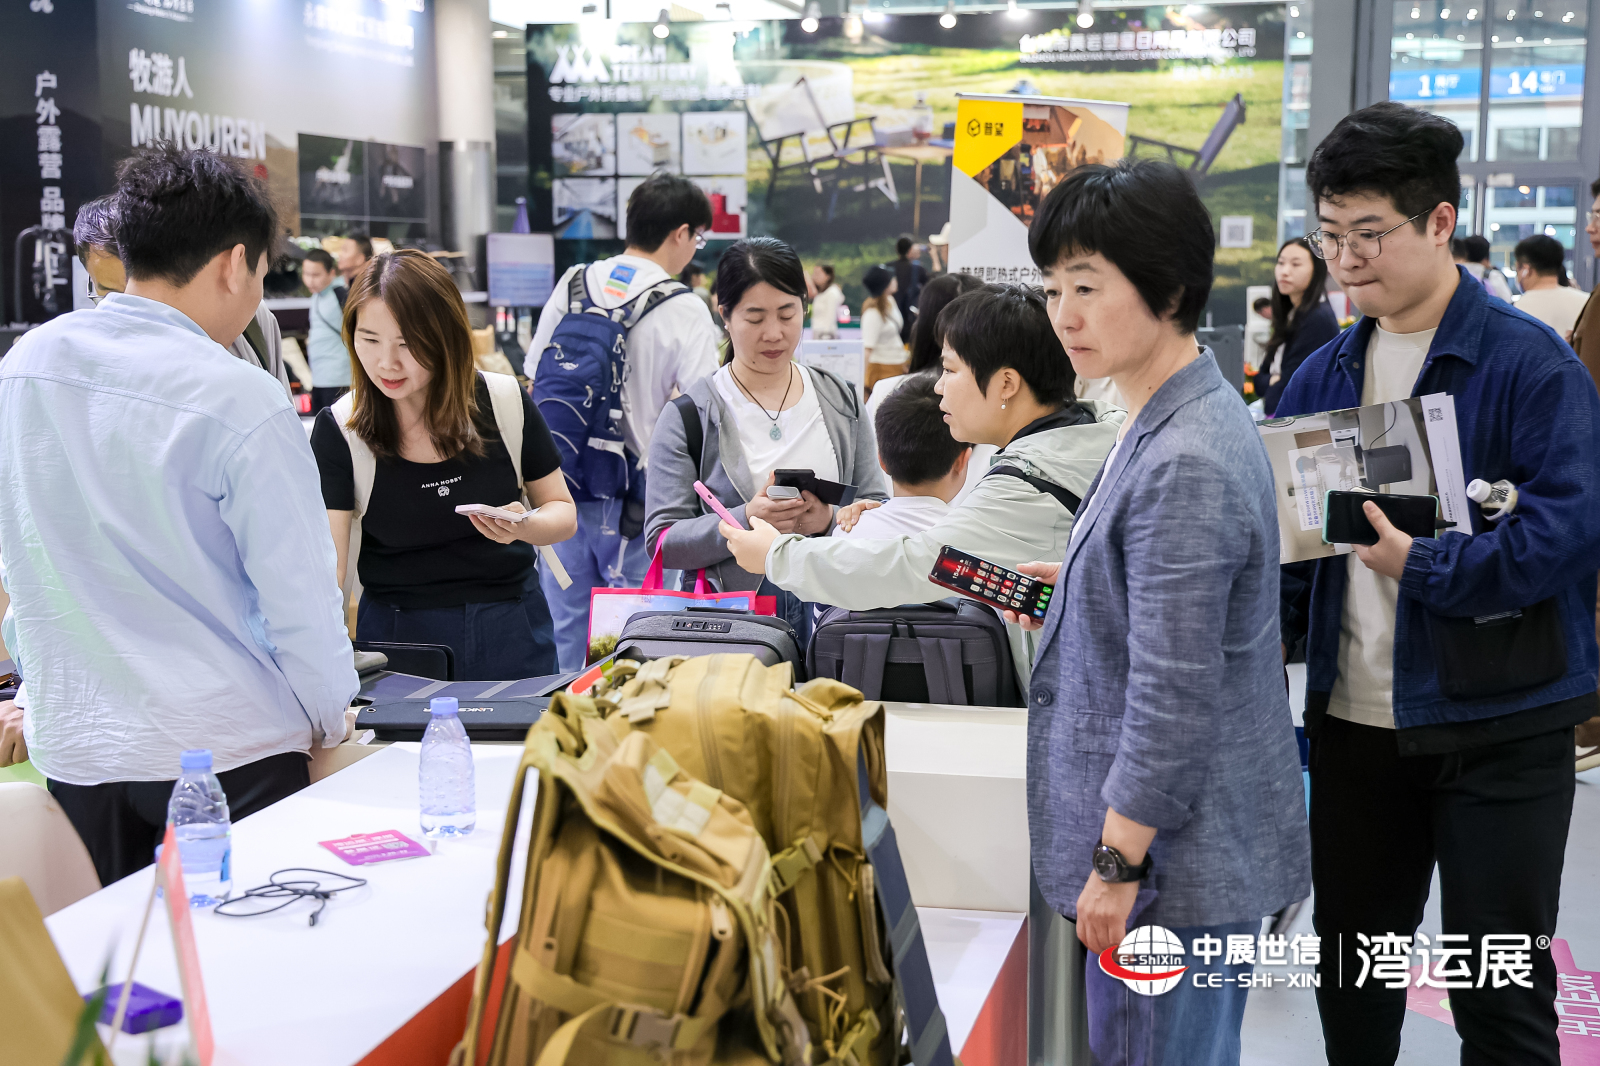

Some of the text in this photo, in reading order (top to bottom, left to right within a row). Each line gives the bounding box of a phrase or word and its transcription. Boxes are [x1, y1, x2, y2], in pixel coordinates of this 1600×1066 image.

[128, 47, 194, 100] 牧游人
[1417, 74, 1432, 98] 1
[1507, 70, 1539, 95] 14
[34, 69, 63, 180] 户外露营
[130, 103, 267, 161] MUYOUREN
[421, 475, 463, 489] ANNA HOBBY
